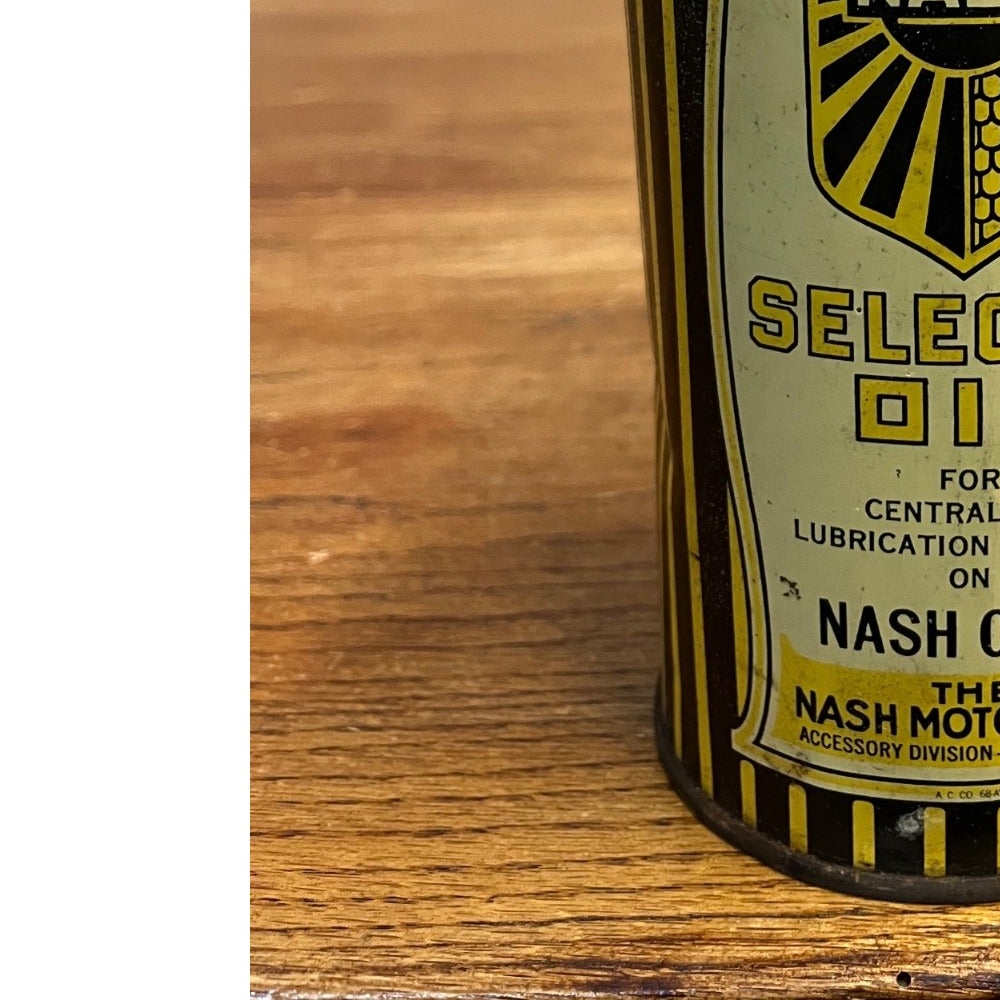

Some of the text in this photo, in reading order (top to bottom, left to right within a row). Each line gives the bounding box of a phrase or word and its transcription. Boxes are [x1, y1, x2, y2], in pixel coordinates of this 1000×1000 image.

[939, 469, 1000, 490] FOR
[794, 519, 989, 557] LUBRICATION
[948, 568, 990, 589] ON
[819, 598, 958, 658] NASH
[796, 687, 898, 735] NASH
[799, 726, 904, 758] ACCESSORY
